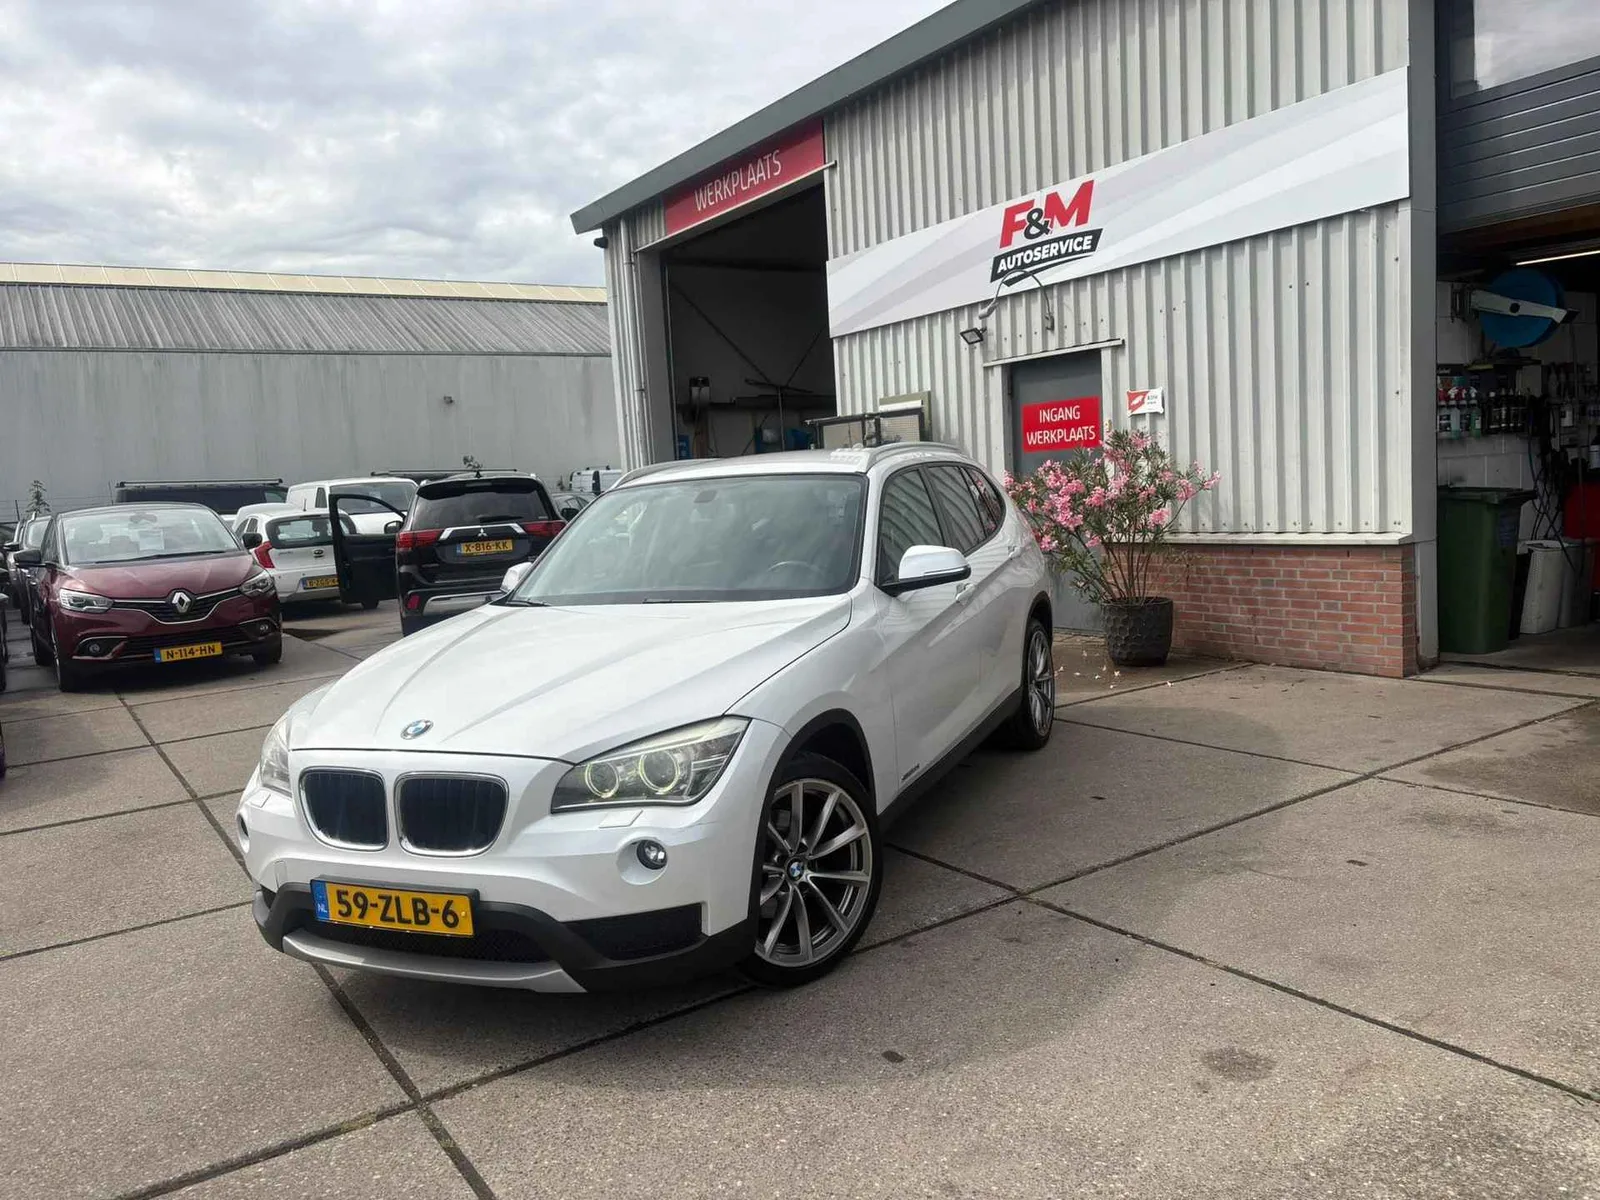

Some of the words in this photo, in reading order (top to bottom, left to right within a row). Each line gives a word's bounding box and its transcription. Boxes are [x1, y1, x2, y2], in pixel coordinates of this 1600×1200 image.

[694, 150, 782, 211] WERKPLAATS
[999, 180, 1095, 249] F&M
[997, 235, 1093, 273] AUTOSERVICE
[1039, 405, 1081, 424] INGANG
[1026, 425, 1096, 446] WERKPLAATS
[464, 541, 509, 553] X-816-KK
[166, 644, 216, 660] N-114-HN
[336, 889, 460, 929] 59-ZLB-6
